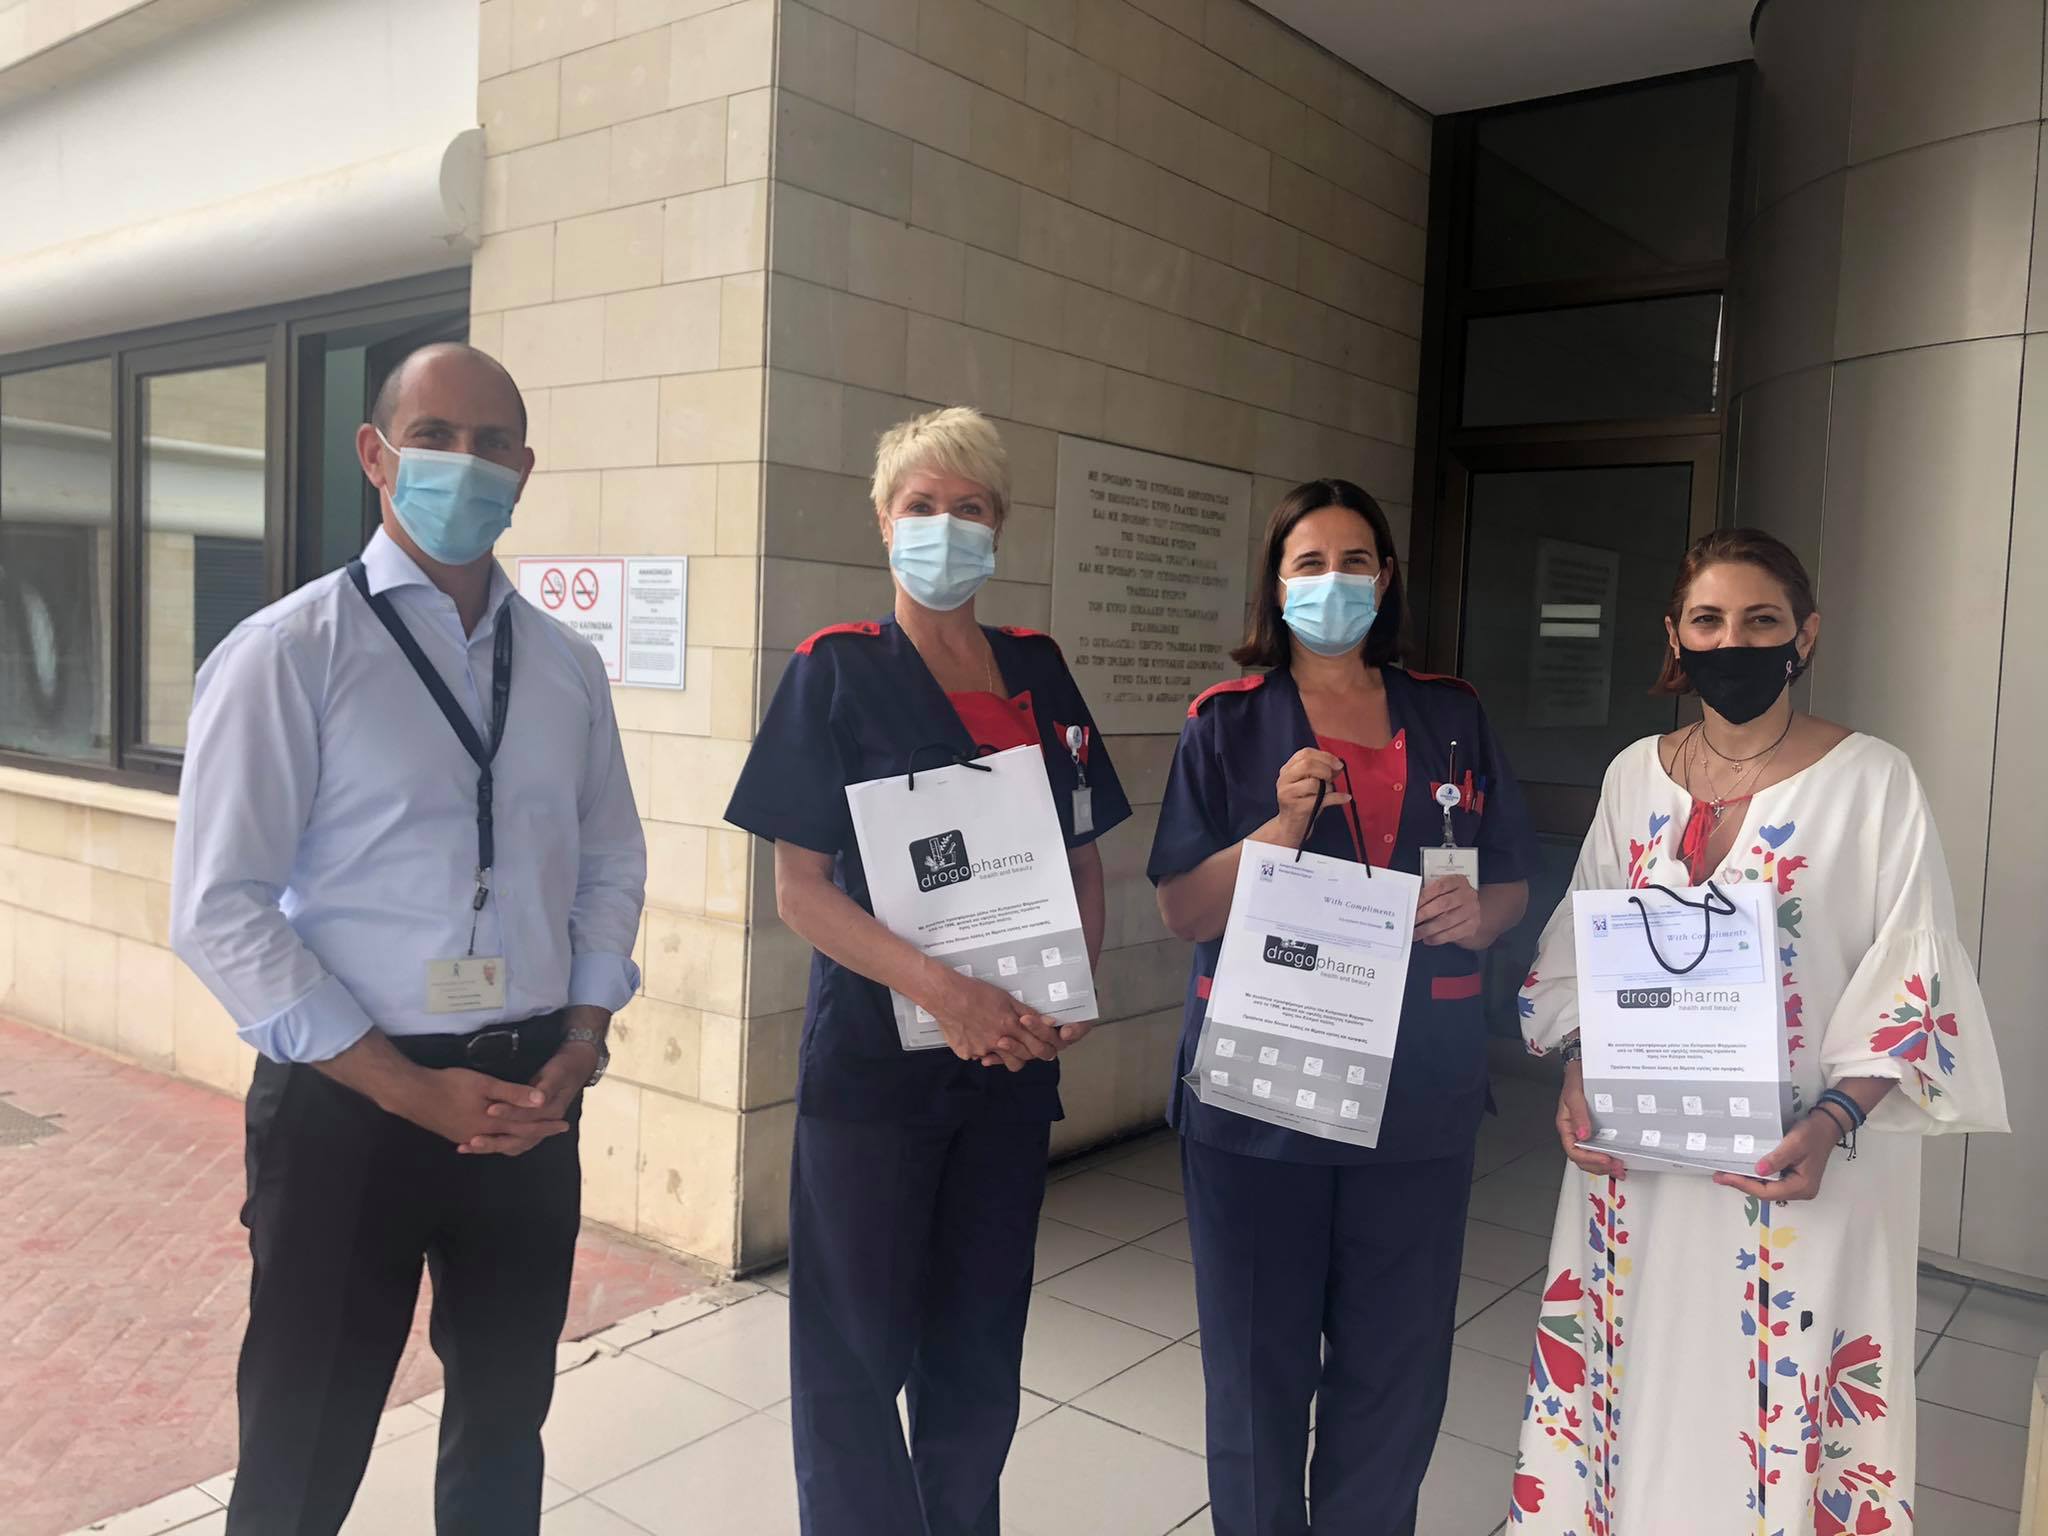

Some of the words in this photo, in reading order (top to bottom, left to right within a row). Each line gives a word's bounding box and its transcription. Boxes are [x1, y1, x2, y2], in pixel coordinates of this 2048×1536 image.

[1324, 896, 1342, 906] With
[1345, 902, 1396, 916] Compliments
[1692, 929, 1746, 942] Copliments
